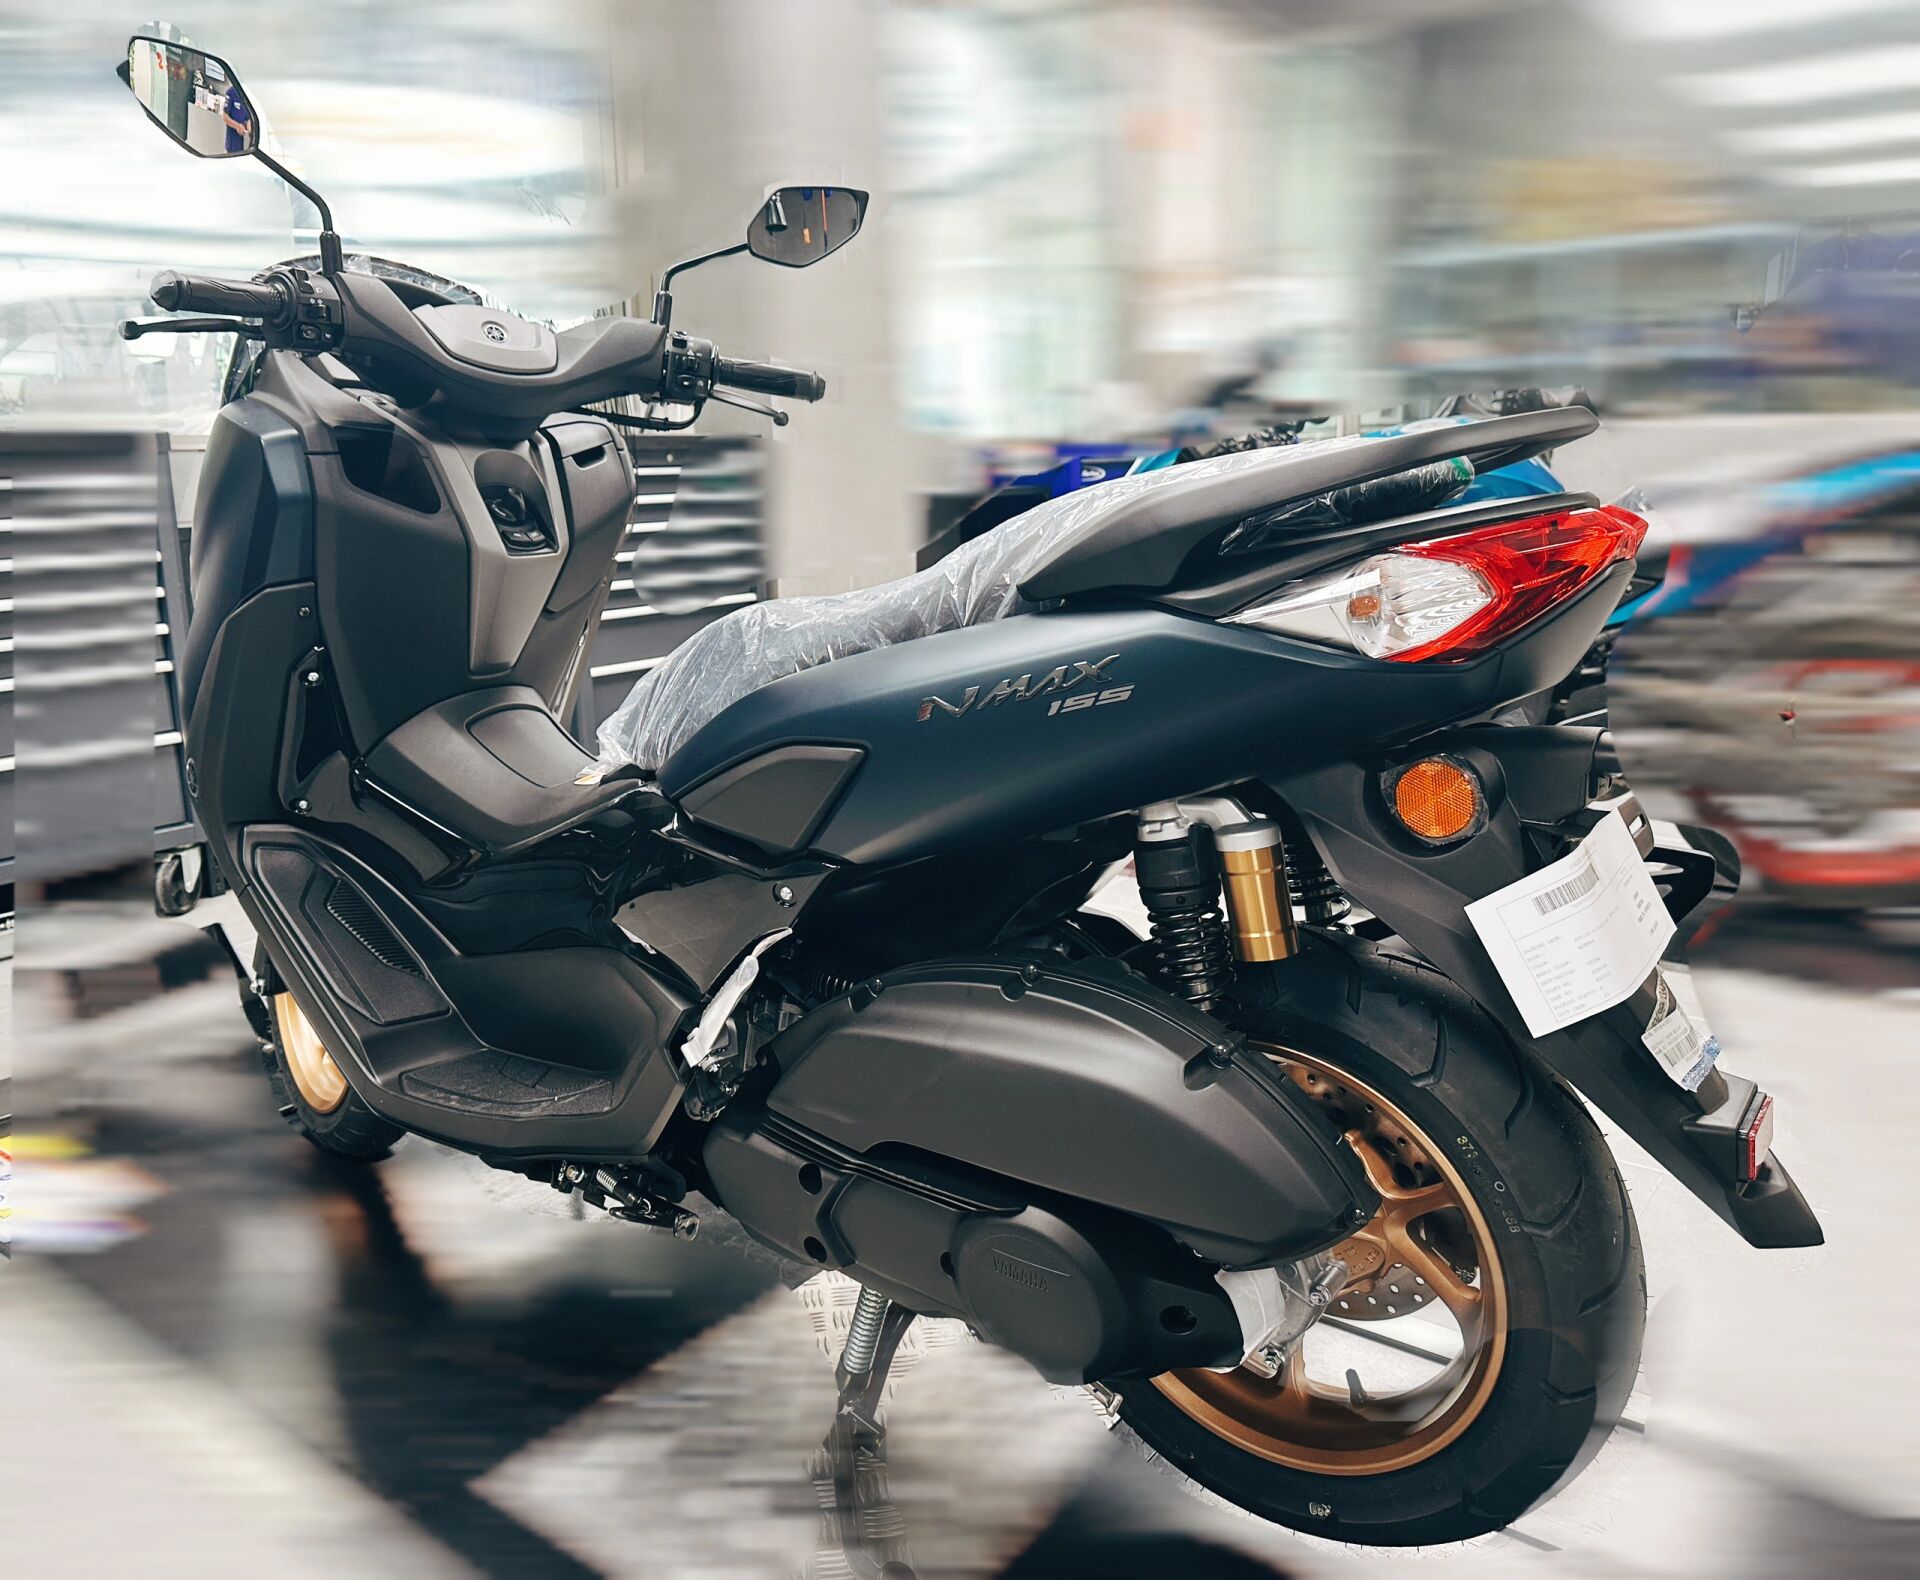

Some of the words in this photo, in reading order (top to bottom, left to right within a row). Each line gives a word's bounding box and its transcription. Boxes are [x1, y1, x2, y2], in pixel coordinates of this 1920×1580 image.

[916, 653, 1120, 722] NMAX
[1047, 684, 1136, 717] 155
[992, 1256, 1049, 1292] YAMAHA
